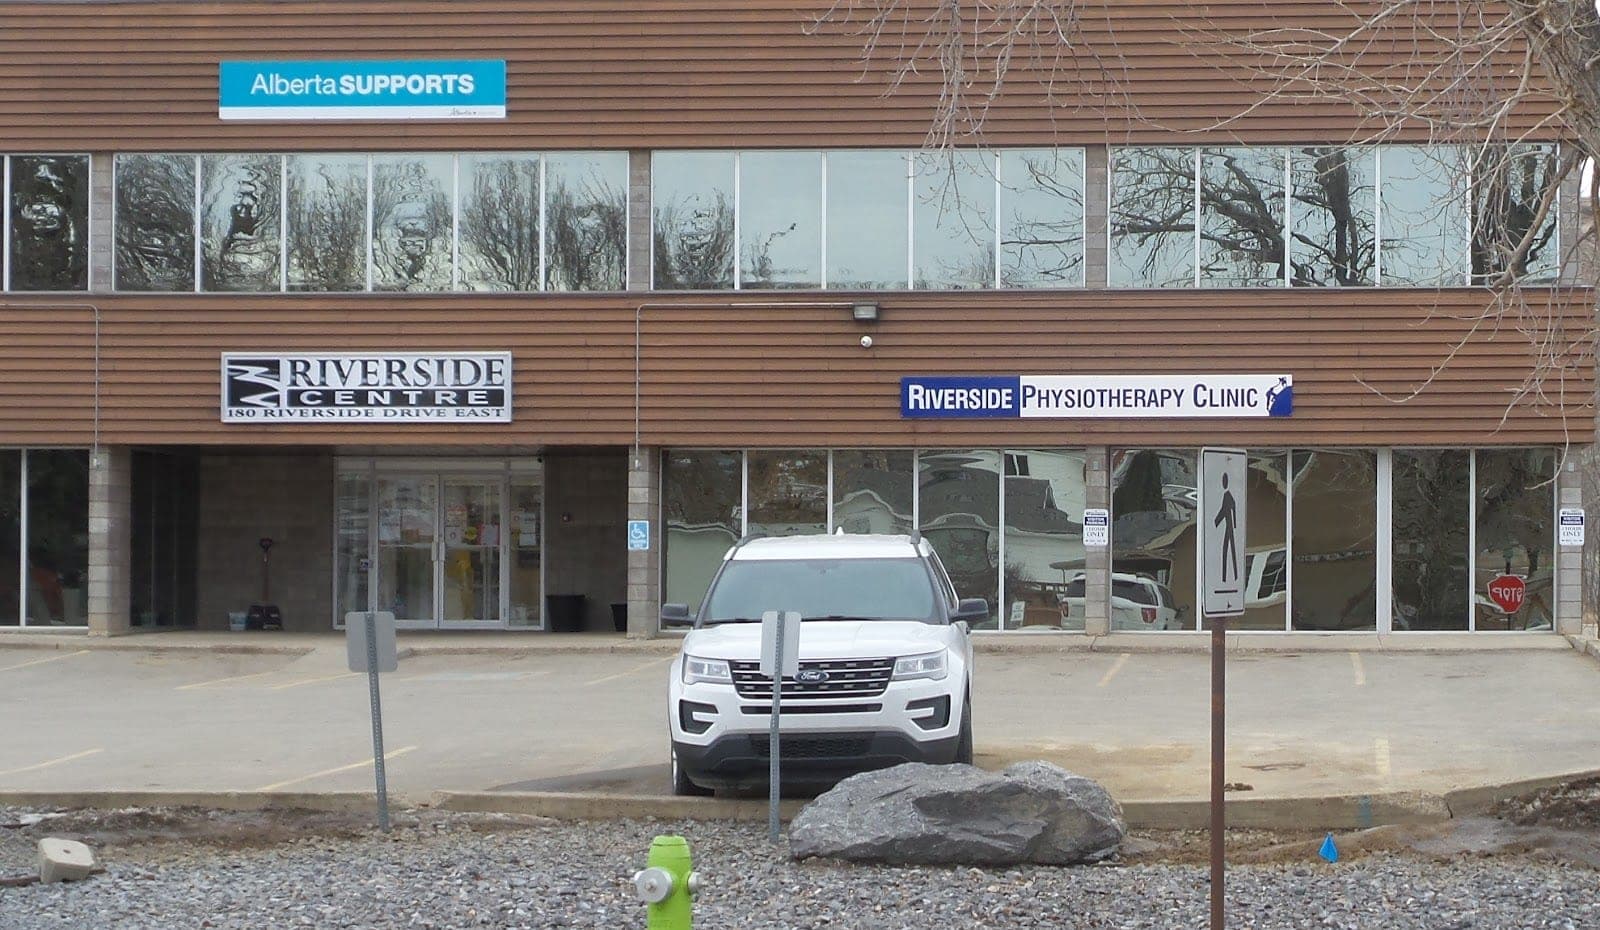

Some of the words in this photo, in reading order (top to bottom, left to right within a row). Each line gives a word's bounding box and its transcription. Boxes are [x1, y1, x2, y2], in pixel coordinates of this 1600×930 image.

[287, 358, 506, 387] RIVERSIDE
[299, 390, 489, 405] CENTRE
[908, 384, 1013, 410] RIVERSIDE
[1021, 384, 1185, 409] PHYSIOTHERAPY
[1192, 383, 1258, 408] CLINIC
[227, 408, 257, 418] 180
[263, 408, 375, 418] RIVERSIDE
[382, 408, 448, 418] DRIVE
[454, 408, 506, 418] EAST
